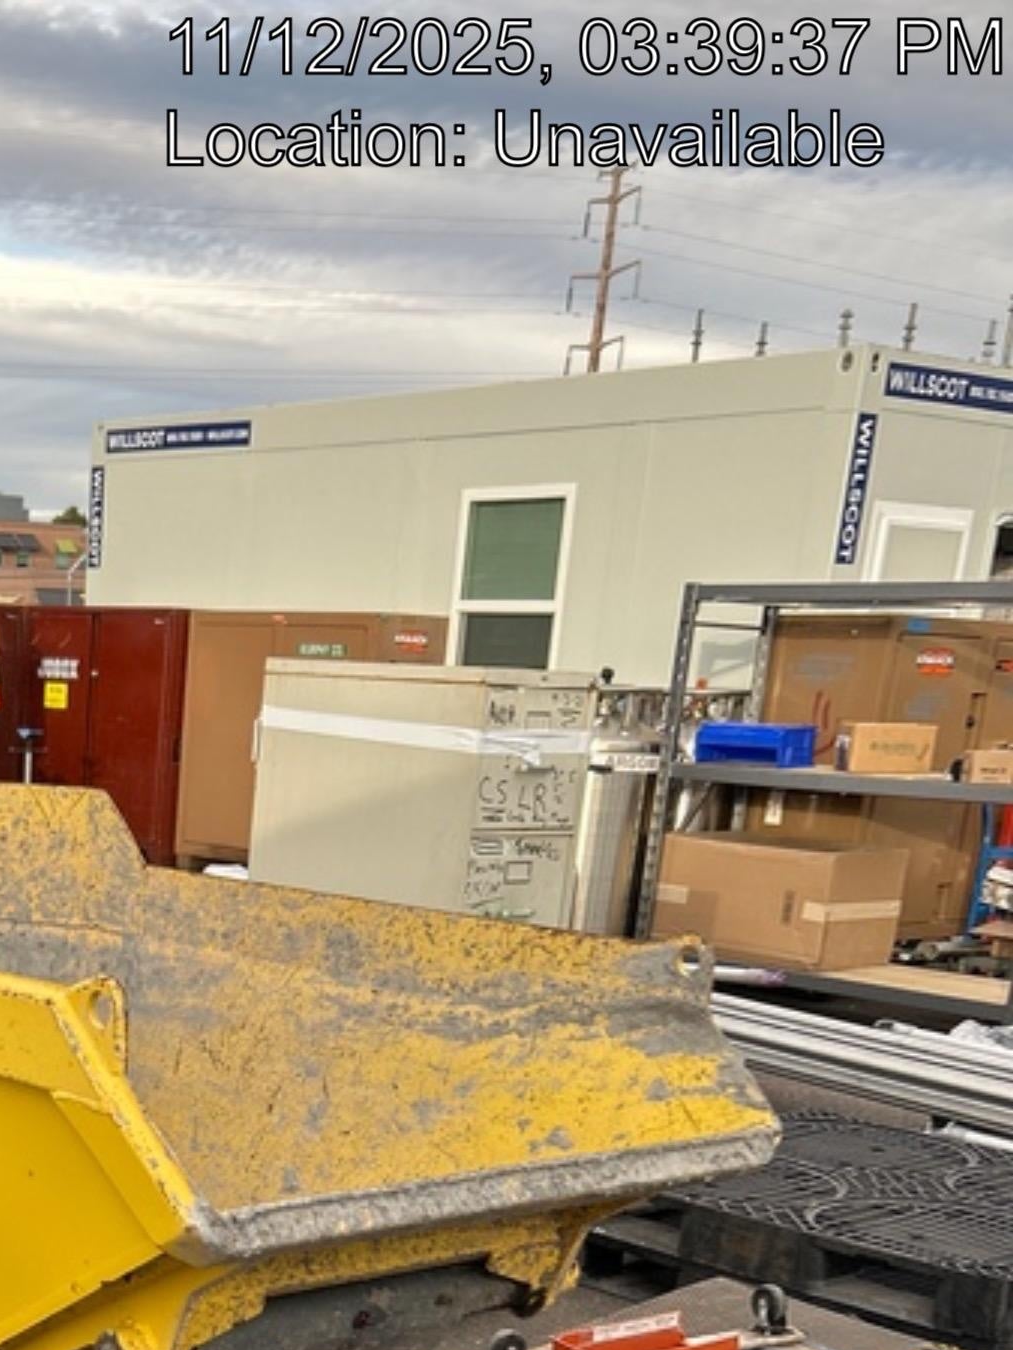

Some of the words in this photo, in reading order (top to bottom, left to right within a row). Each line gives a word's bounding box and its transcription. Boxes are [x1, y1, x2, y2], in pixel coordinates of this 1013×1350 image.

[890, 367, 969, 400] WILLSCOT
[109, 431, 165, 449] WILLSCOT
[839, 419, 874, 563] WILLSCOT
